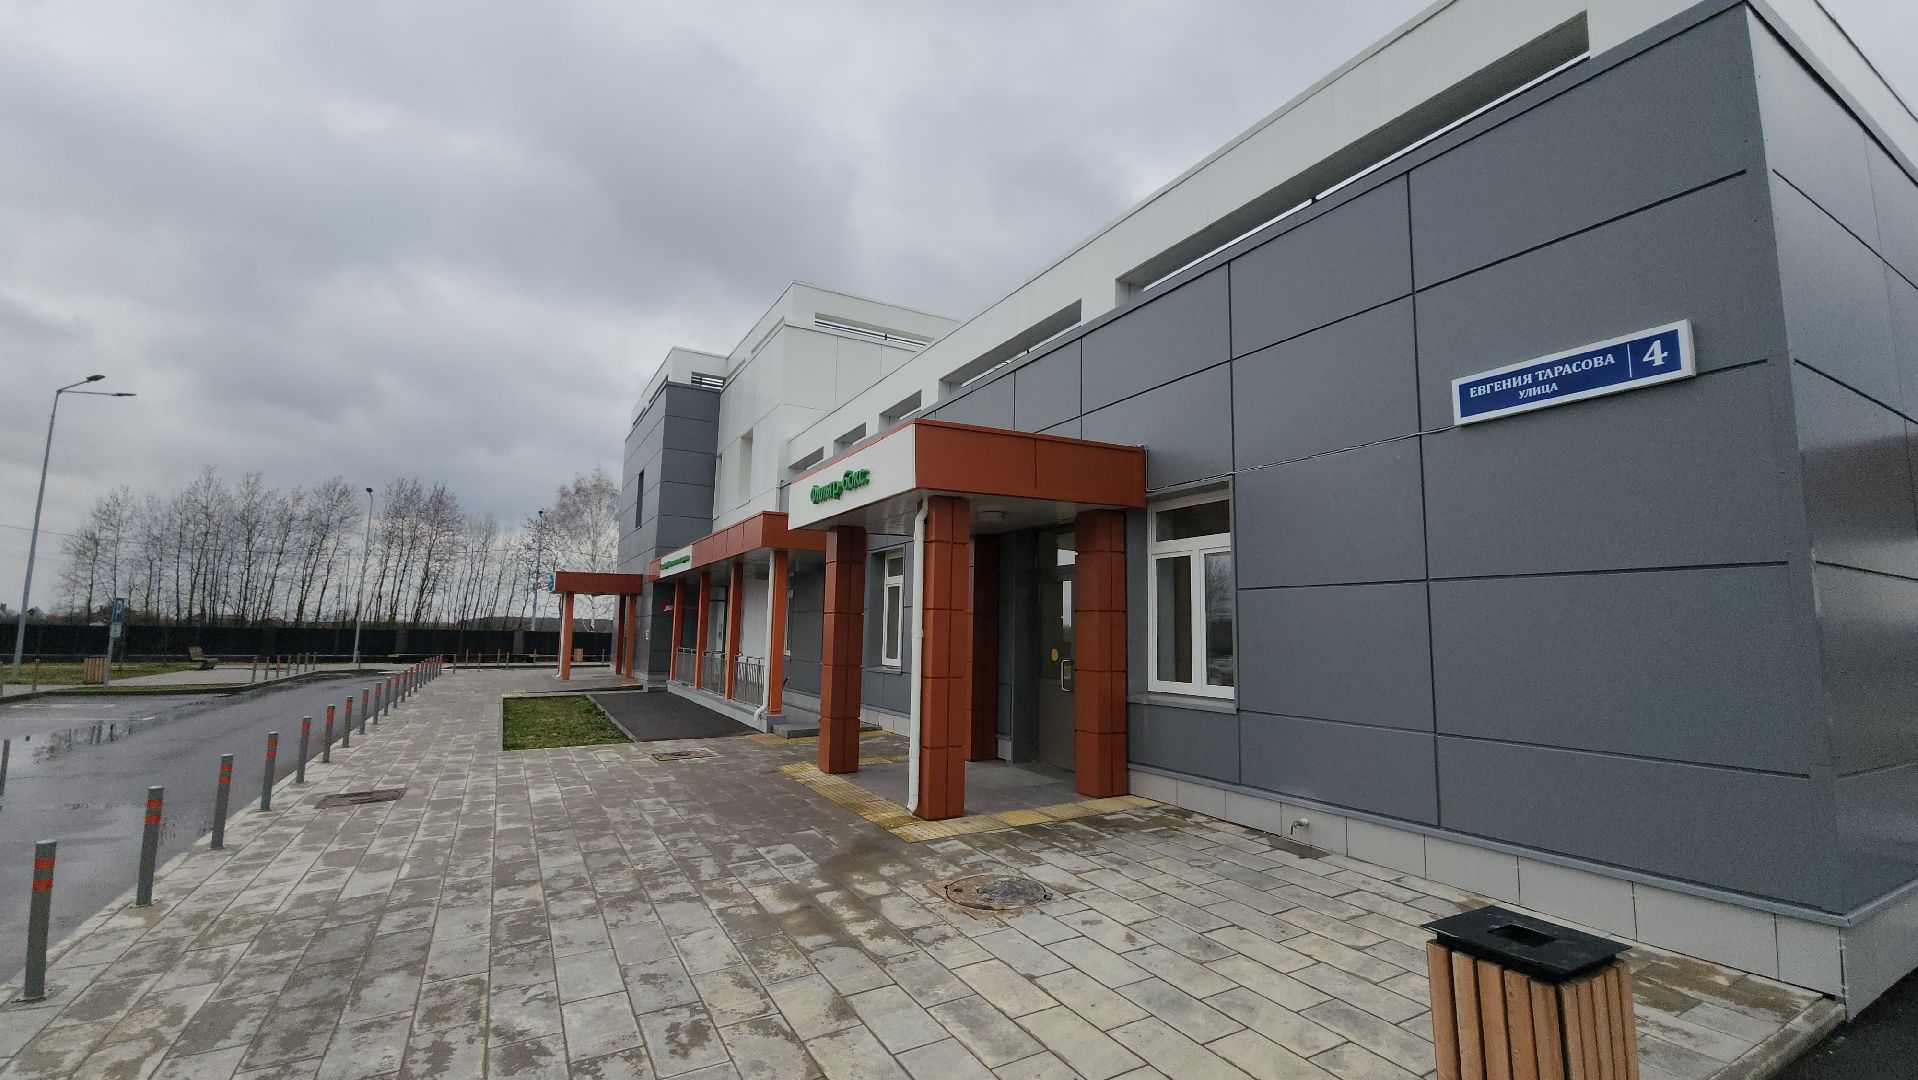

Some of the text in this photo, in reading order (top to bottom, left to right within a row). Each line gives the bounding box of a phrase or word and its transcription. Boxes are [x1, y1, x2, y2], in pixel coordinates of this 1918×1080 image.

[1642, 339, 1669, 367] 4
[1469, 353, 1616, 398] ЕВГЕНИЯ ТАРАСОВА
[1518, 382, 1558, 400] УЛИЦА
